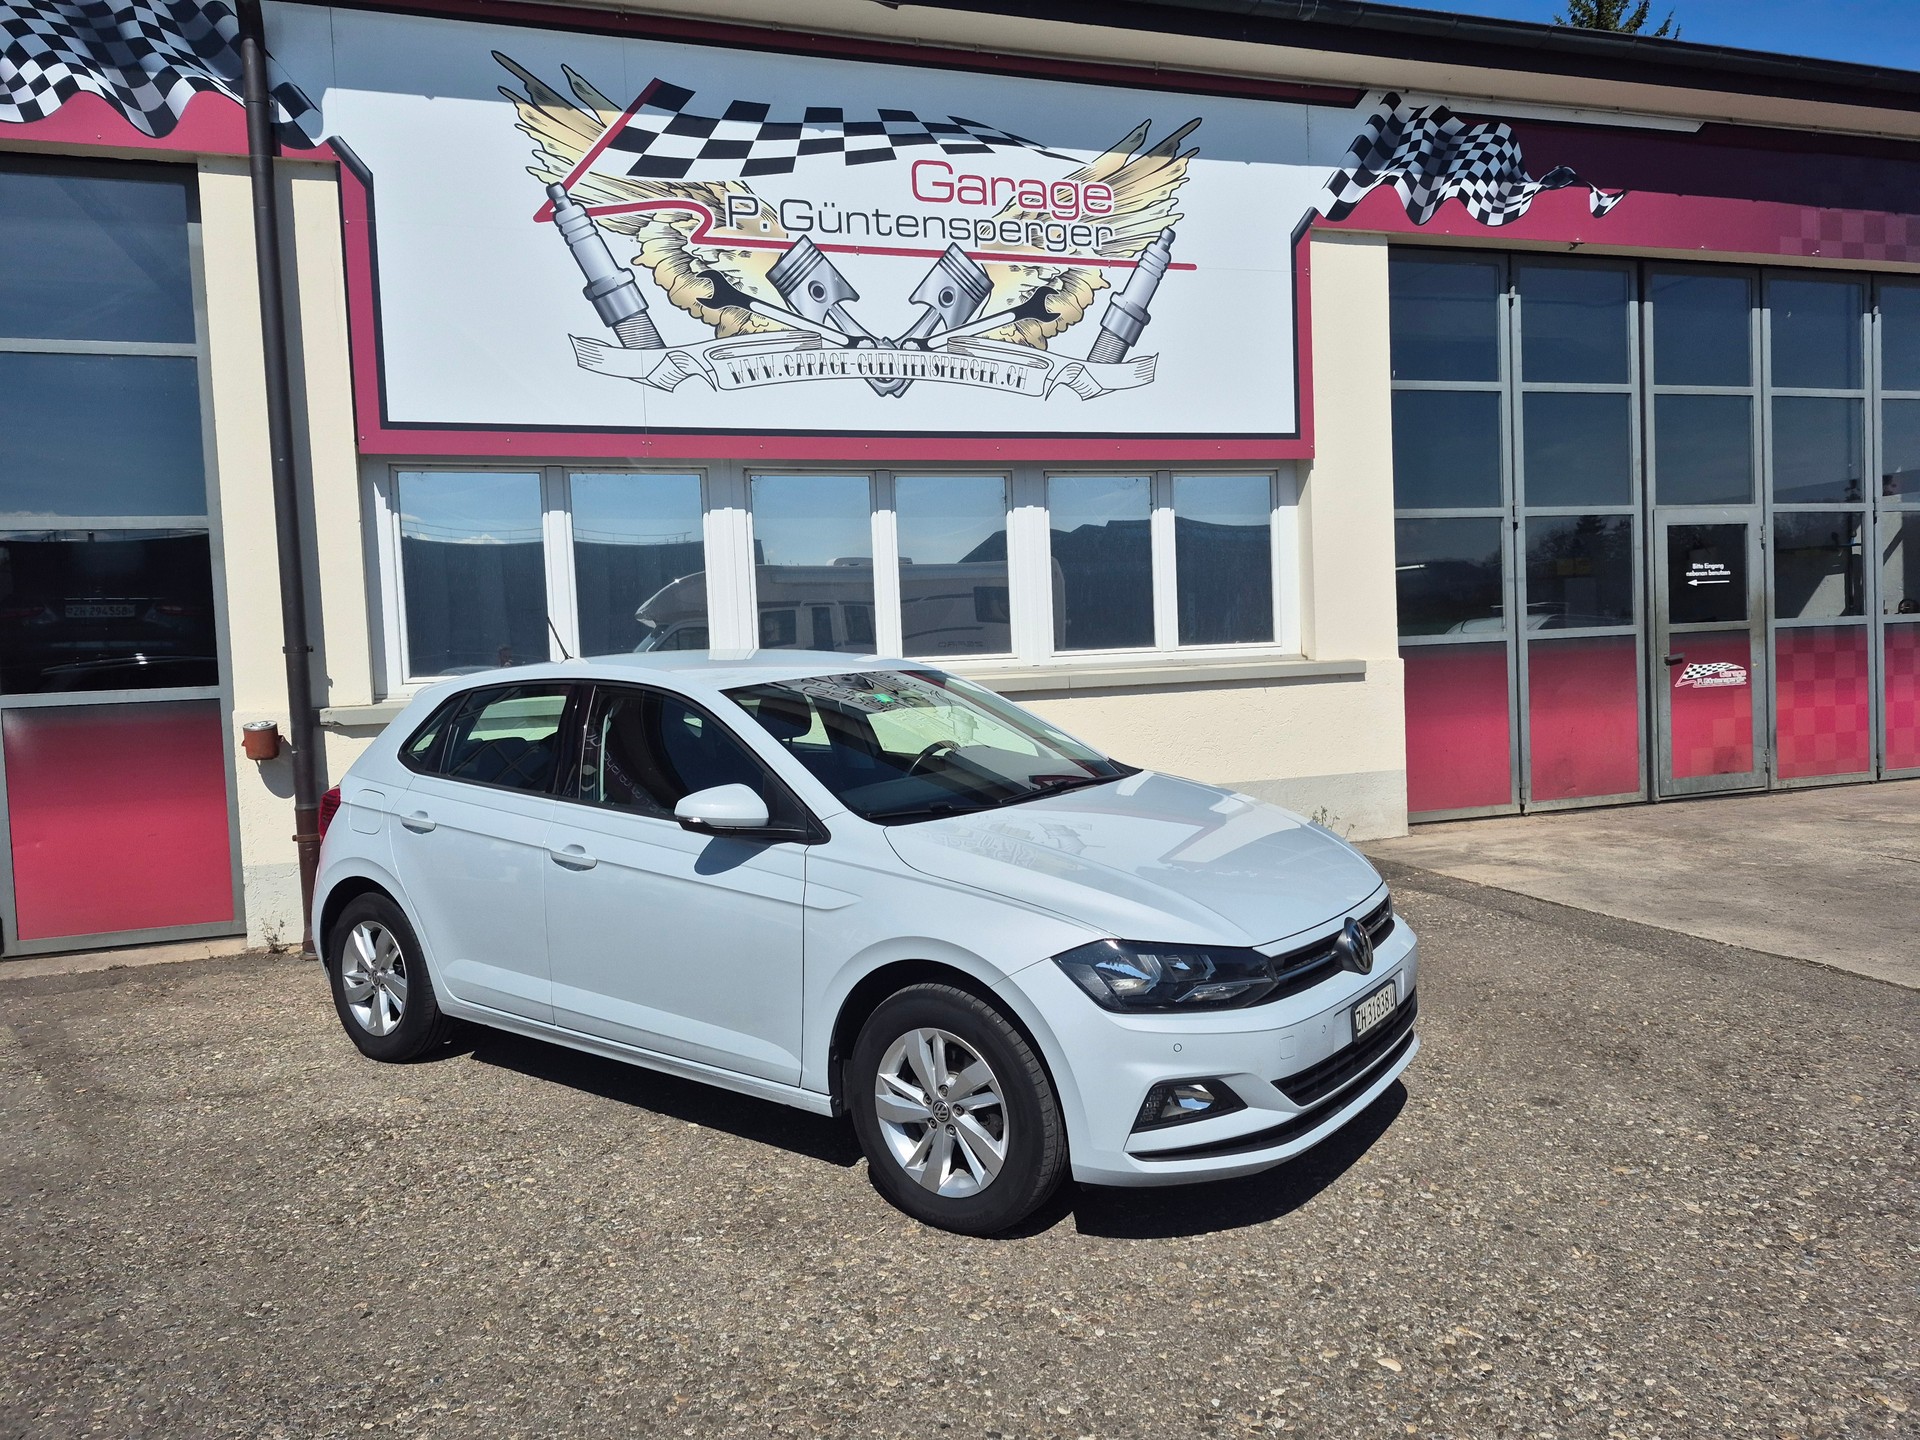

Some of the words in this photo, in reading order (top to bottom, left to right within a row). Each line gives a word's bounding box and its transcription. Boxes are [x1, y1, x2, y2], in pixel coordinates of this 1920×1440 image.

[911, 159, 1113, 221] Garage
[727, 196, 769, 231] P.
[779, 199, 1114, 250] Güntensperger
[727, 352, 1029, 390] WWW.GARAGE-GUENTENSPERGER.CH
